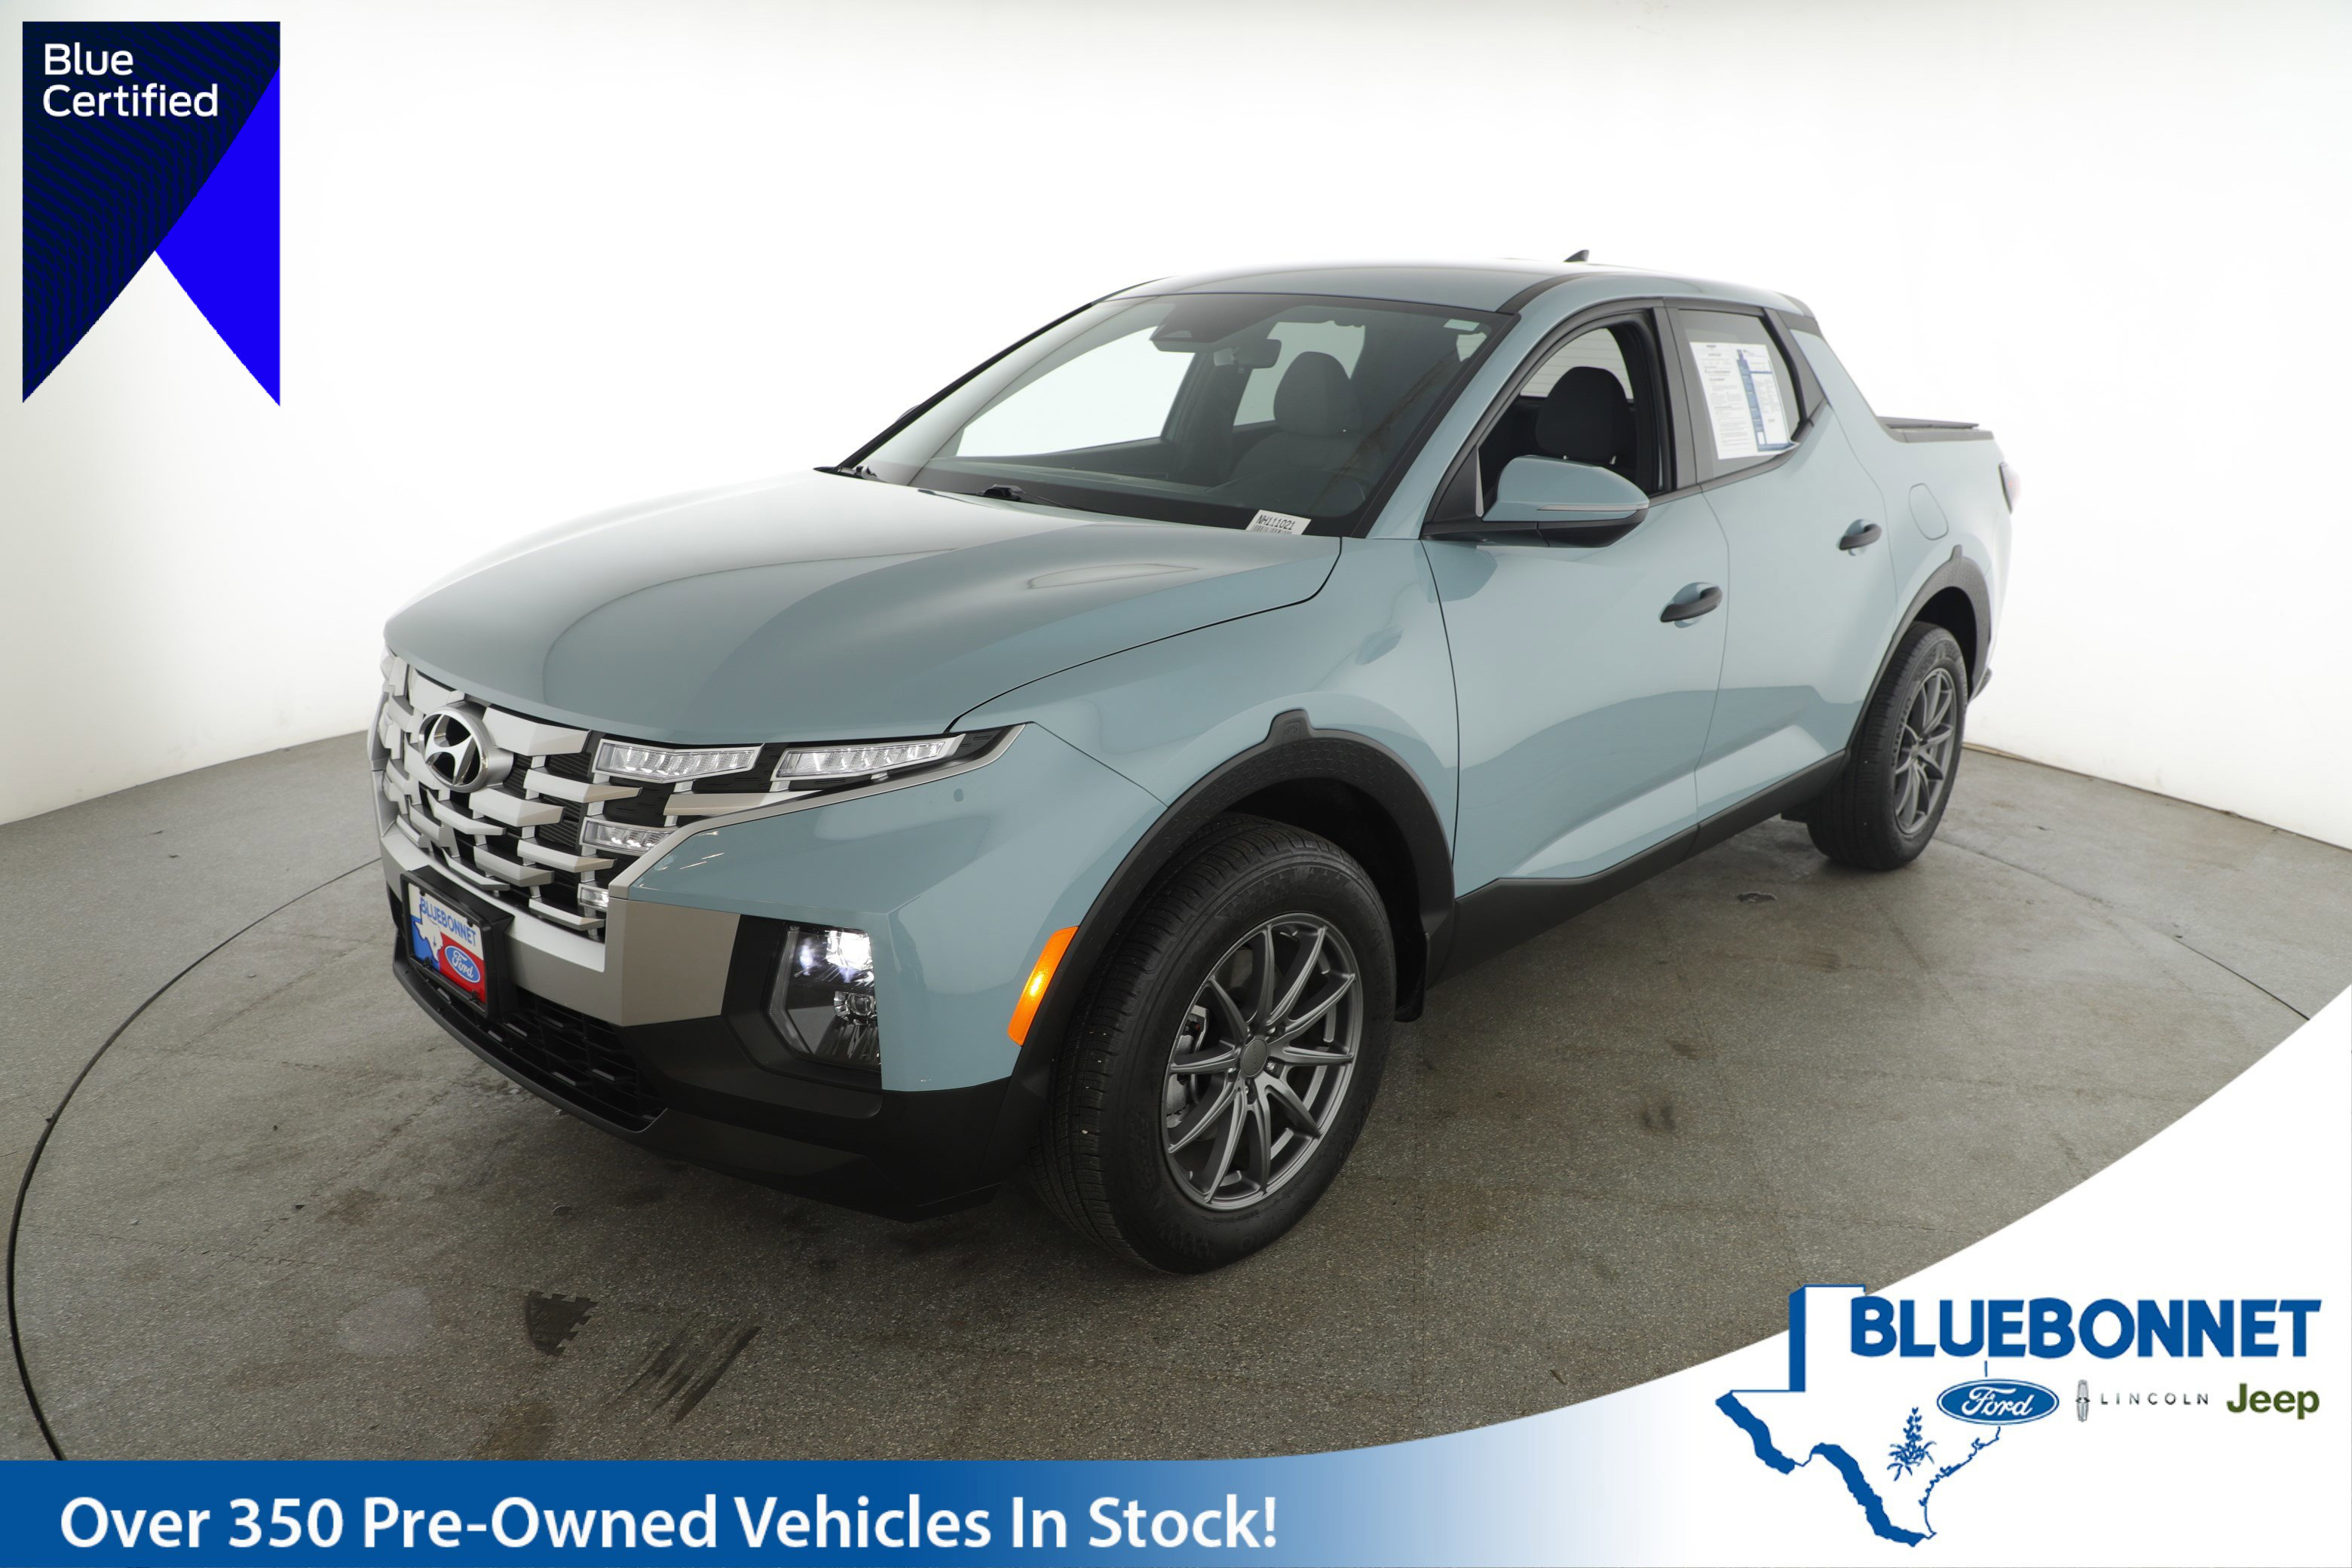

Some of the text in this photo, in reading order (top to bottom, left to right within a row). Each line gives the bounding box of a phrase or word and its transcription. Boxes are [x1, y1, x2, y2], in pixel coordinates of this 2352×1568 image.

[1257, 514, 1296, 530] NH111021
[420, 897, 476, 947] BLUEBONNET
[451, 949, 475, 978] Ford
